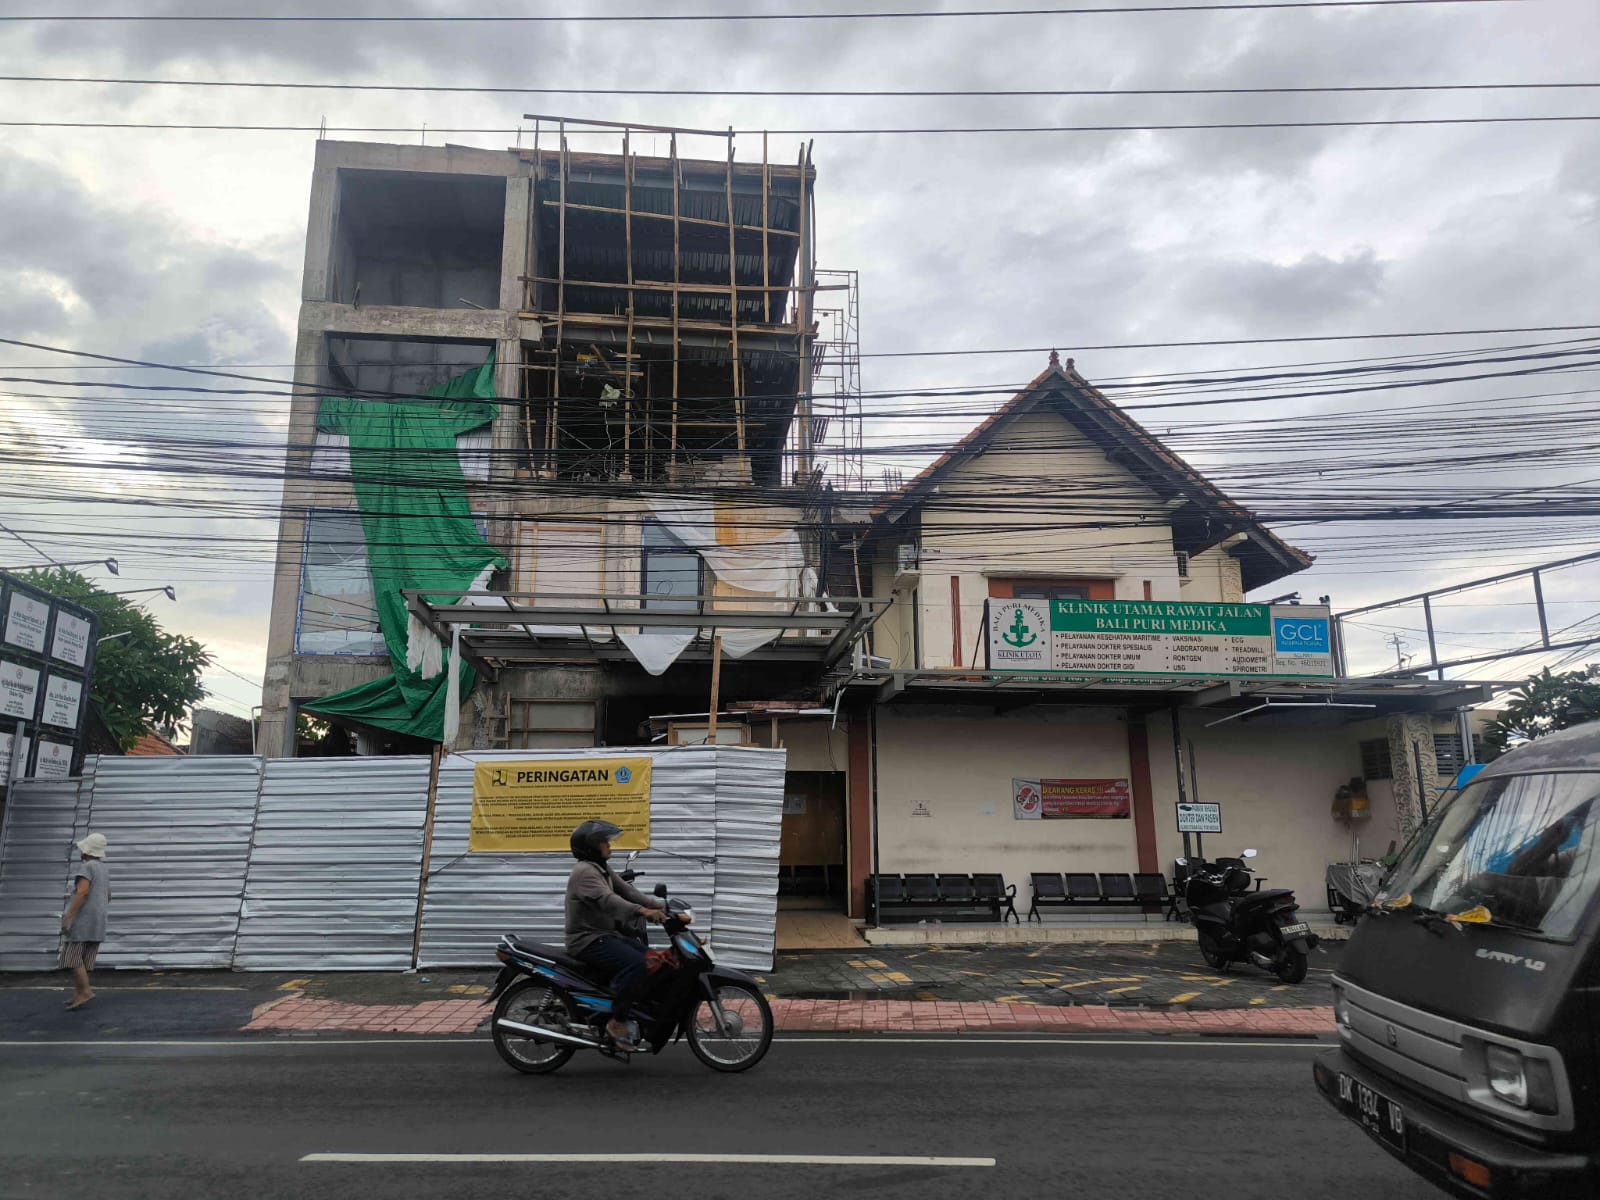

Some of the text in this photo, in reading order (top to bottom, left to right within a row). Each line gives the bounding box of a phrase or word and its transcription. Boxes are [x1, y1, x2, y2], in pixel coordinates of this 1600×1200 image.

[1058, 602, 1262, 618] KLINIK UTAMA RAWAT JALAN
[1096, 618, 1226, 632] BALI PURI MEDIKA
[1280, 624, 1322, 641] GCL
[1173, 645, 1219, 653] LABORATORIUM
[517, 769, 609, 783] PERINGATAN
[1339, 1073, 1353, 1103] DK
